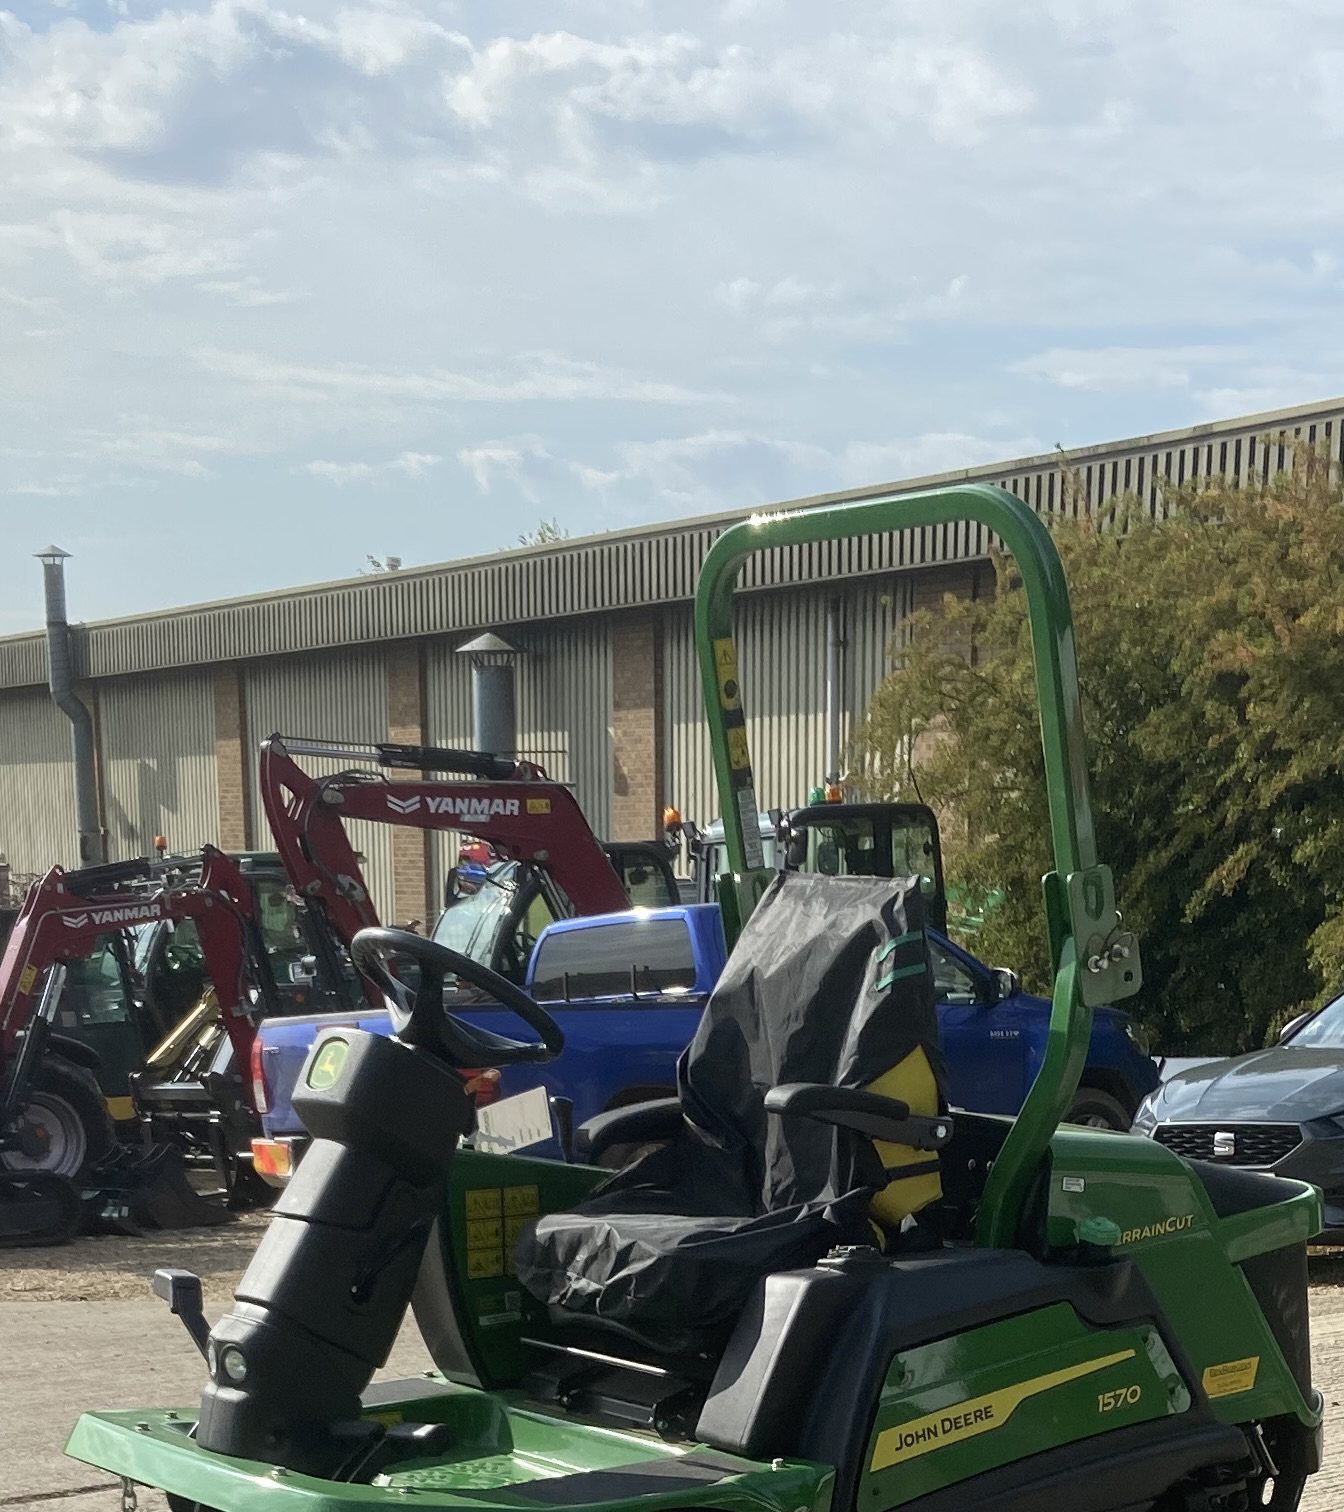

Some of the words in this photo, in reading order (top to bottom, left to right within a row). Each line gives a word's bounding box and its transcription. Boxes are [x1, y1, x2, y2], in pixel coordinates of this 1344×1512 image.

[425, 796, 520, 816] YANMAR
[91, 904, 161, 925] YANMAR
[1097, 1385, 1141, 1412] 1570
[895, 1424, 938, 1451] JOHN
[941, 1405, 994, 1435] DEERE
